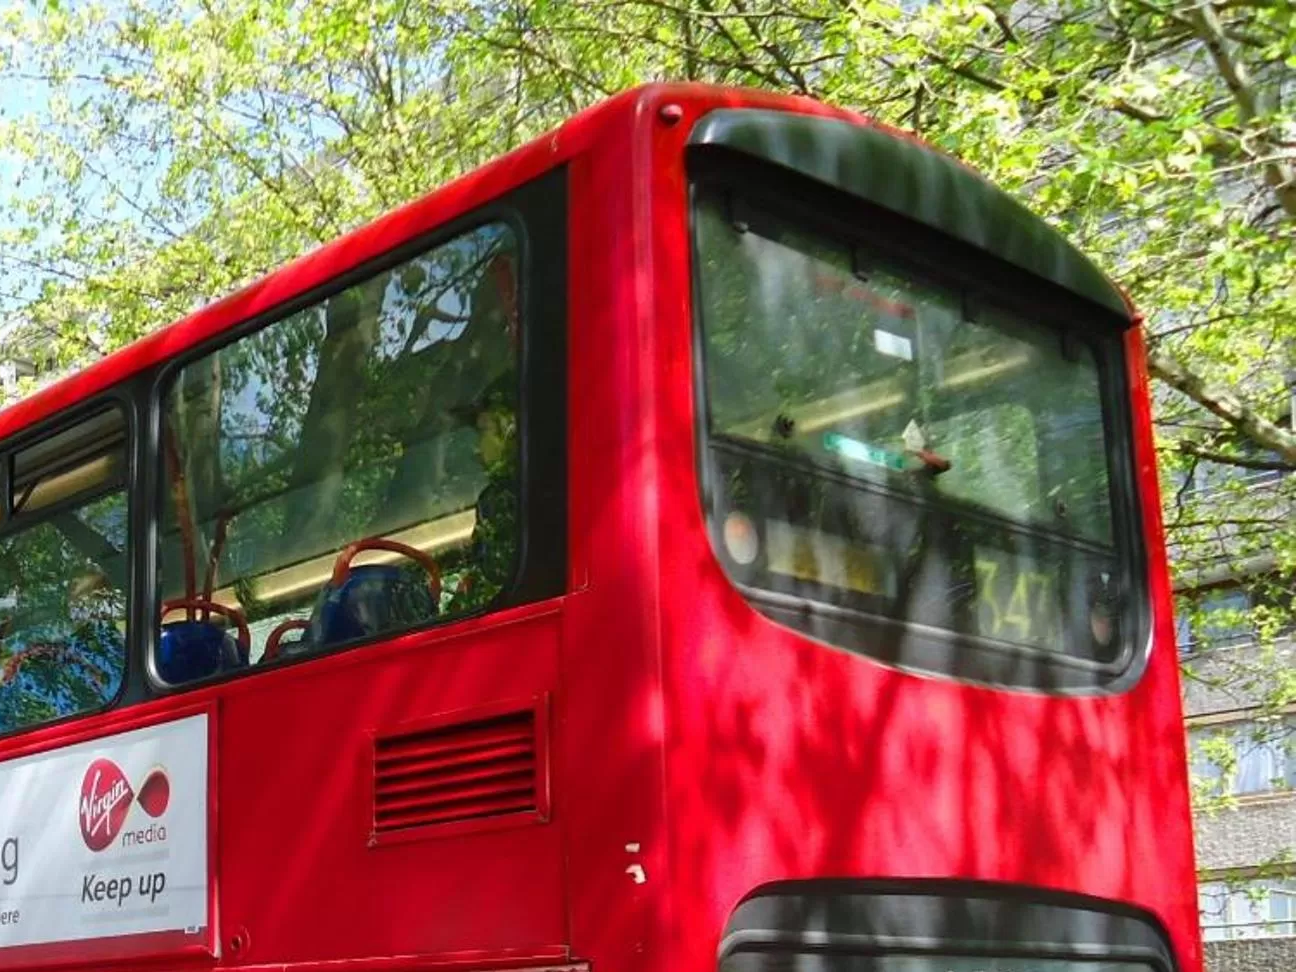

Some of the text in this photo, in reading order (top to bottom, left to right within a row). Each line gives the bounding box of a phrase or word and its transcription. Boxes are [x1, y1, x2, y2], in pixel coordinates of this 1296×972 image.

[81, 769, 129, 836] Virgin
[122, 824, 167, 847] media
[81, 872, 166, 907] Keep up
